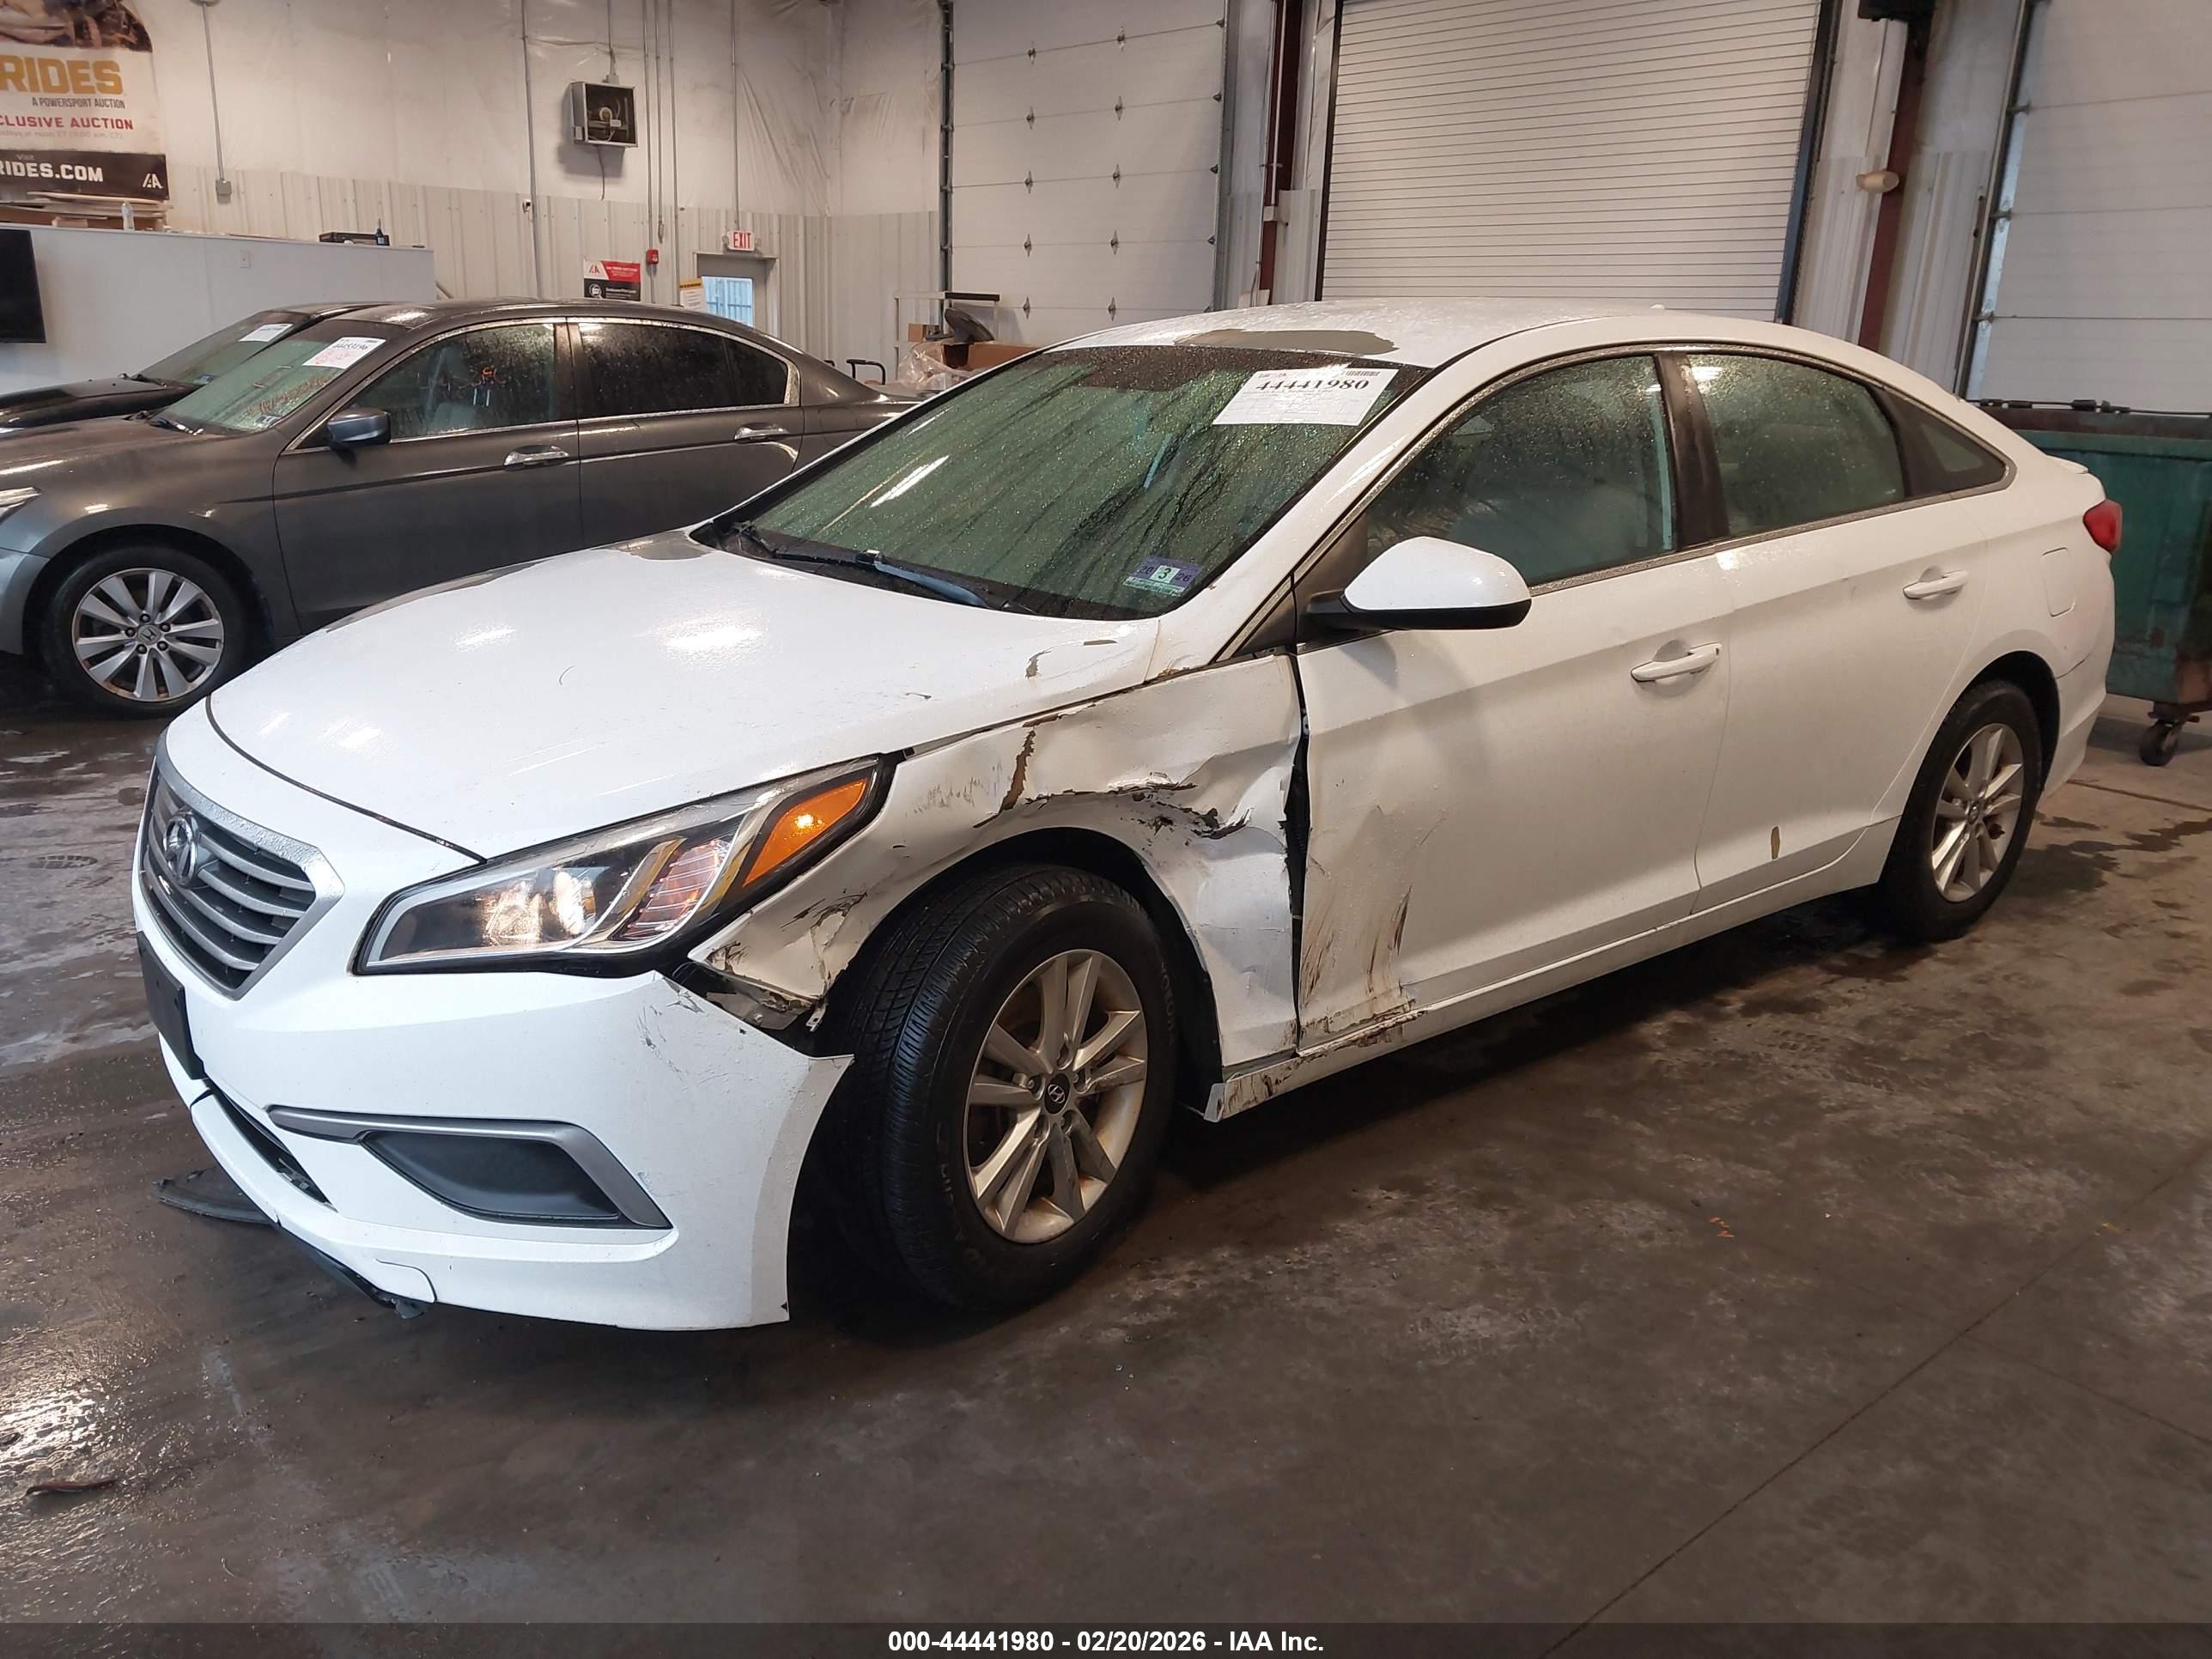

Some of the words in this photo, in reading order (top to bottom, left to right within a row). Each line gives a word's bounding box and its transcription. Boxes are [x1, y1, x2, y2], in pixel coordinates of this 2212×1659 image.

[0, 55, 123, 94] RIDES
[32, 97, 38, 106] A
[40, 97, 92, 108] POWERSPORT
[94, 99, 125, 109] AUCTION
[70, 117, 134, 130] AUCTION
[733, 232, 751, 248] EXIT
[1255, 379, 1370, 391] 44441980
[1158, 568, 1172, 580] 3
